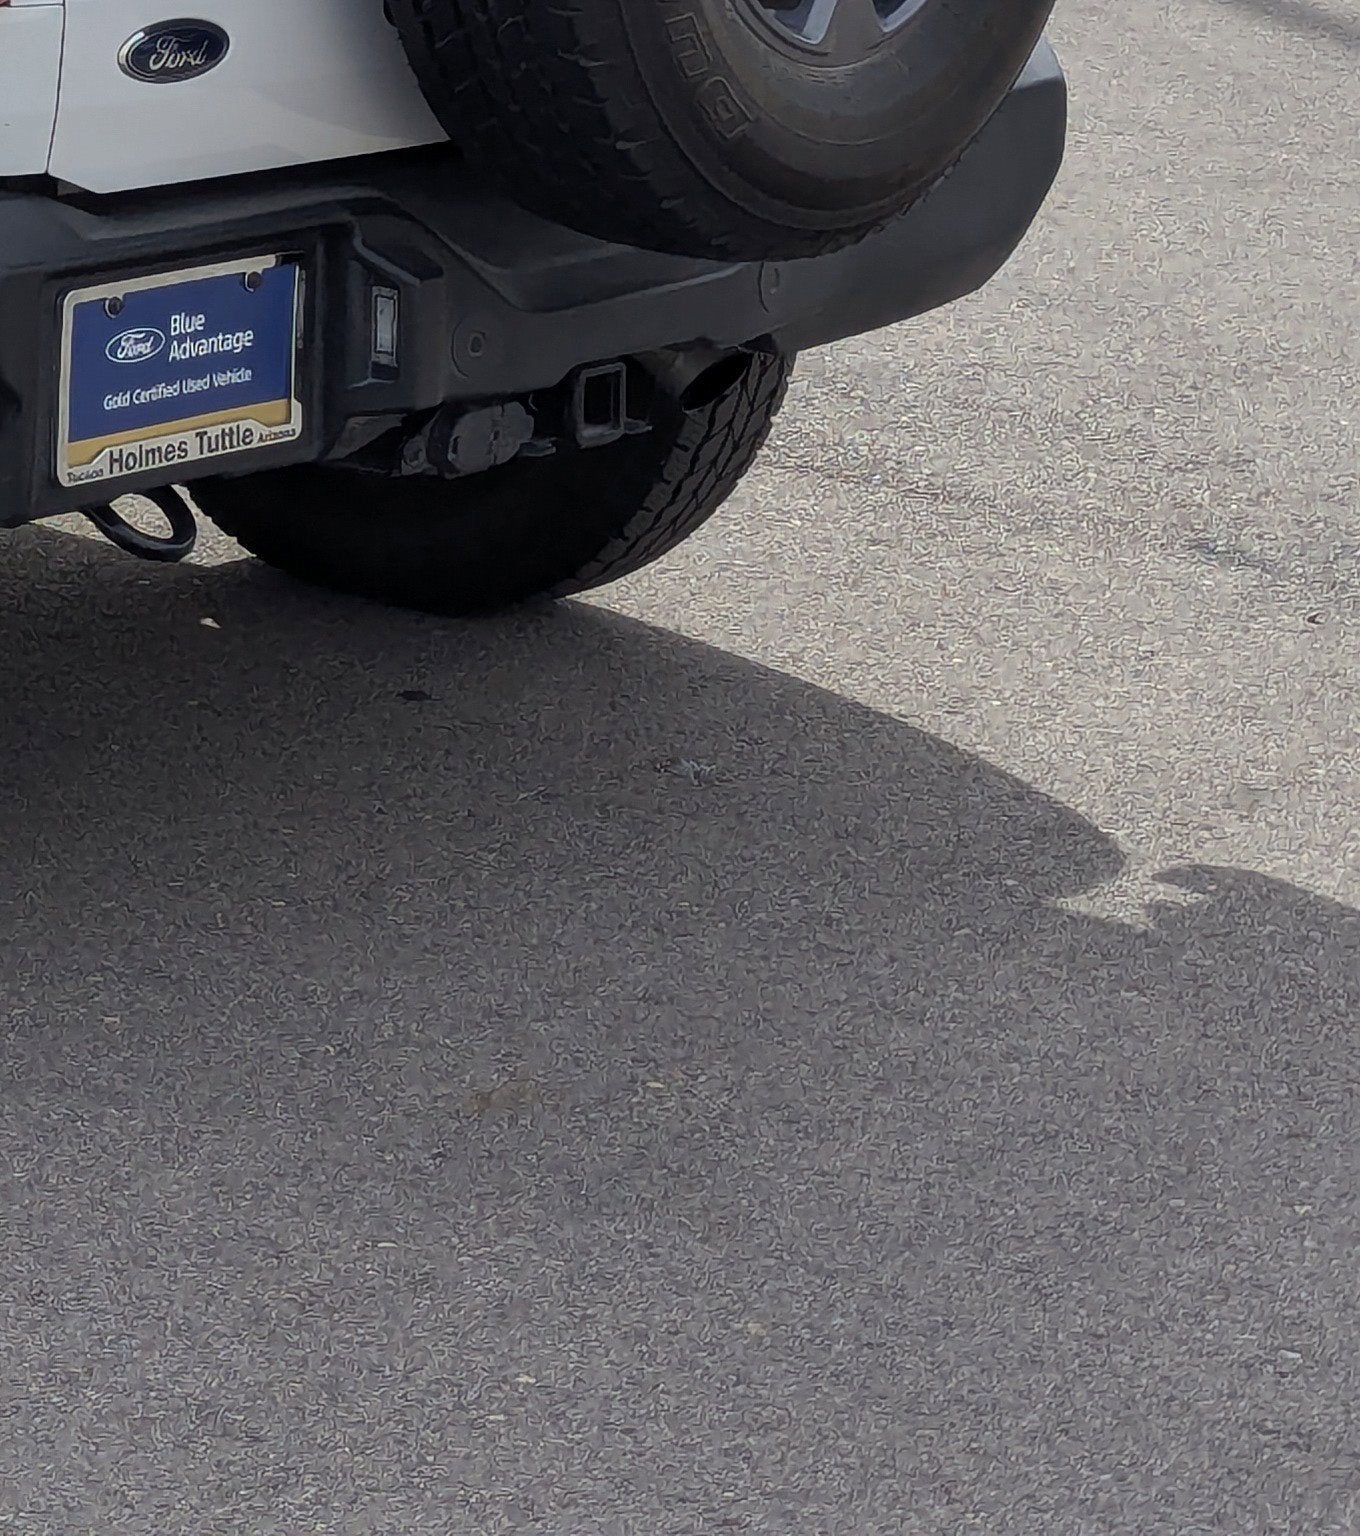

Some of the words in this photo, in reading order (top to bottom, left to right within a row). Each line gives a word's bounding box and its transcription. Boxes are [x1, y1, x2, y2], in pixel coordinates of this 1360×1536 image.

[148, 34, 210, 71] Ford
[170, 312, 205, 336] Blue
[116, 332, 155, 359] Ford
[168, 330, 254, 363] Advantage
[103, 390, 131, 411] Gold
[132, 380, 181, 405] Certified
[182, 373, 211, 394] Used
[212, 367, 253, 388] Vehicle
[109, 440, 189, 475] Holmes
[195, 423, 255, 456] Tuttle
